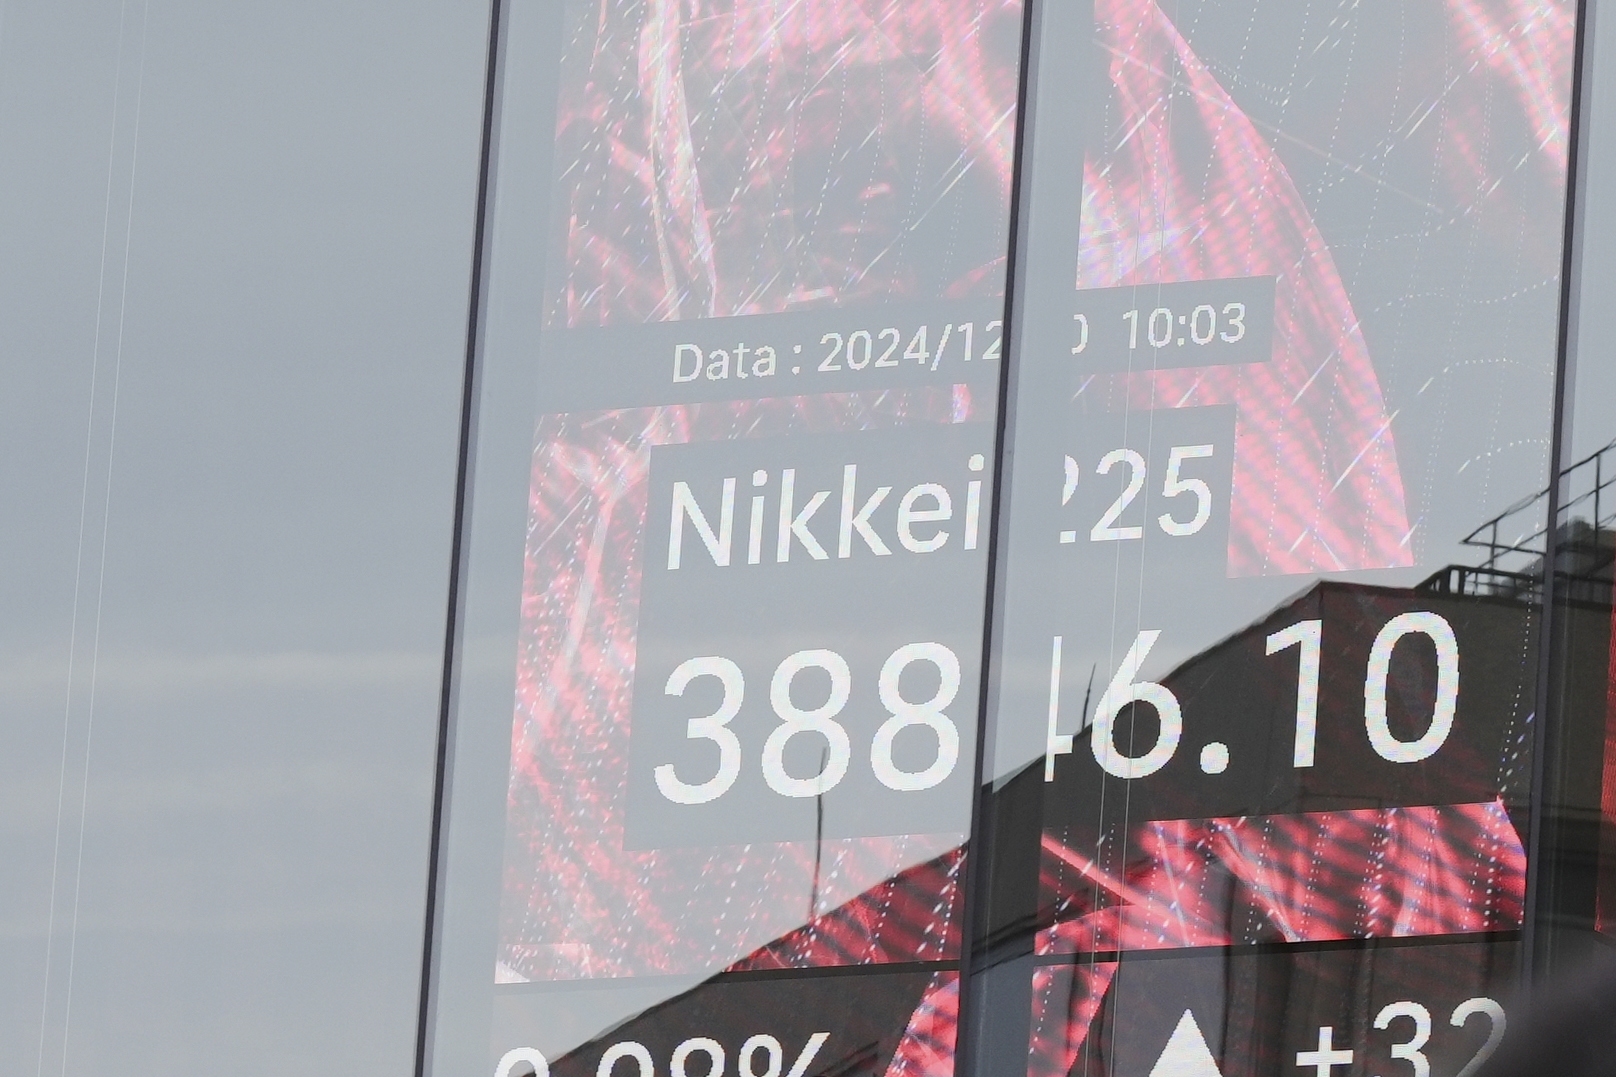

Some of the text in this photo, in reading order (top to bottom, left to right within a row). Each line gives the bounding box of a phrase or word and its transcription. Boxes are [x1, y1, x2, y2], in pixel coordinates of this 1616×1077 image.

[673, 342, 776, 383] Data
[1122, 303, 1246, 349] 10:03
[667, 453, 985, 570] Nikkei
